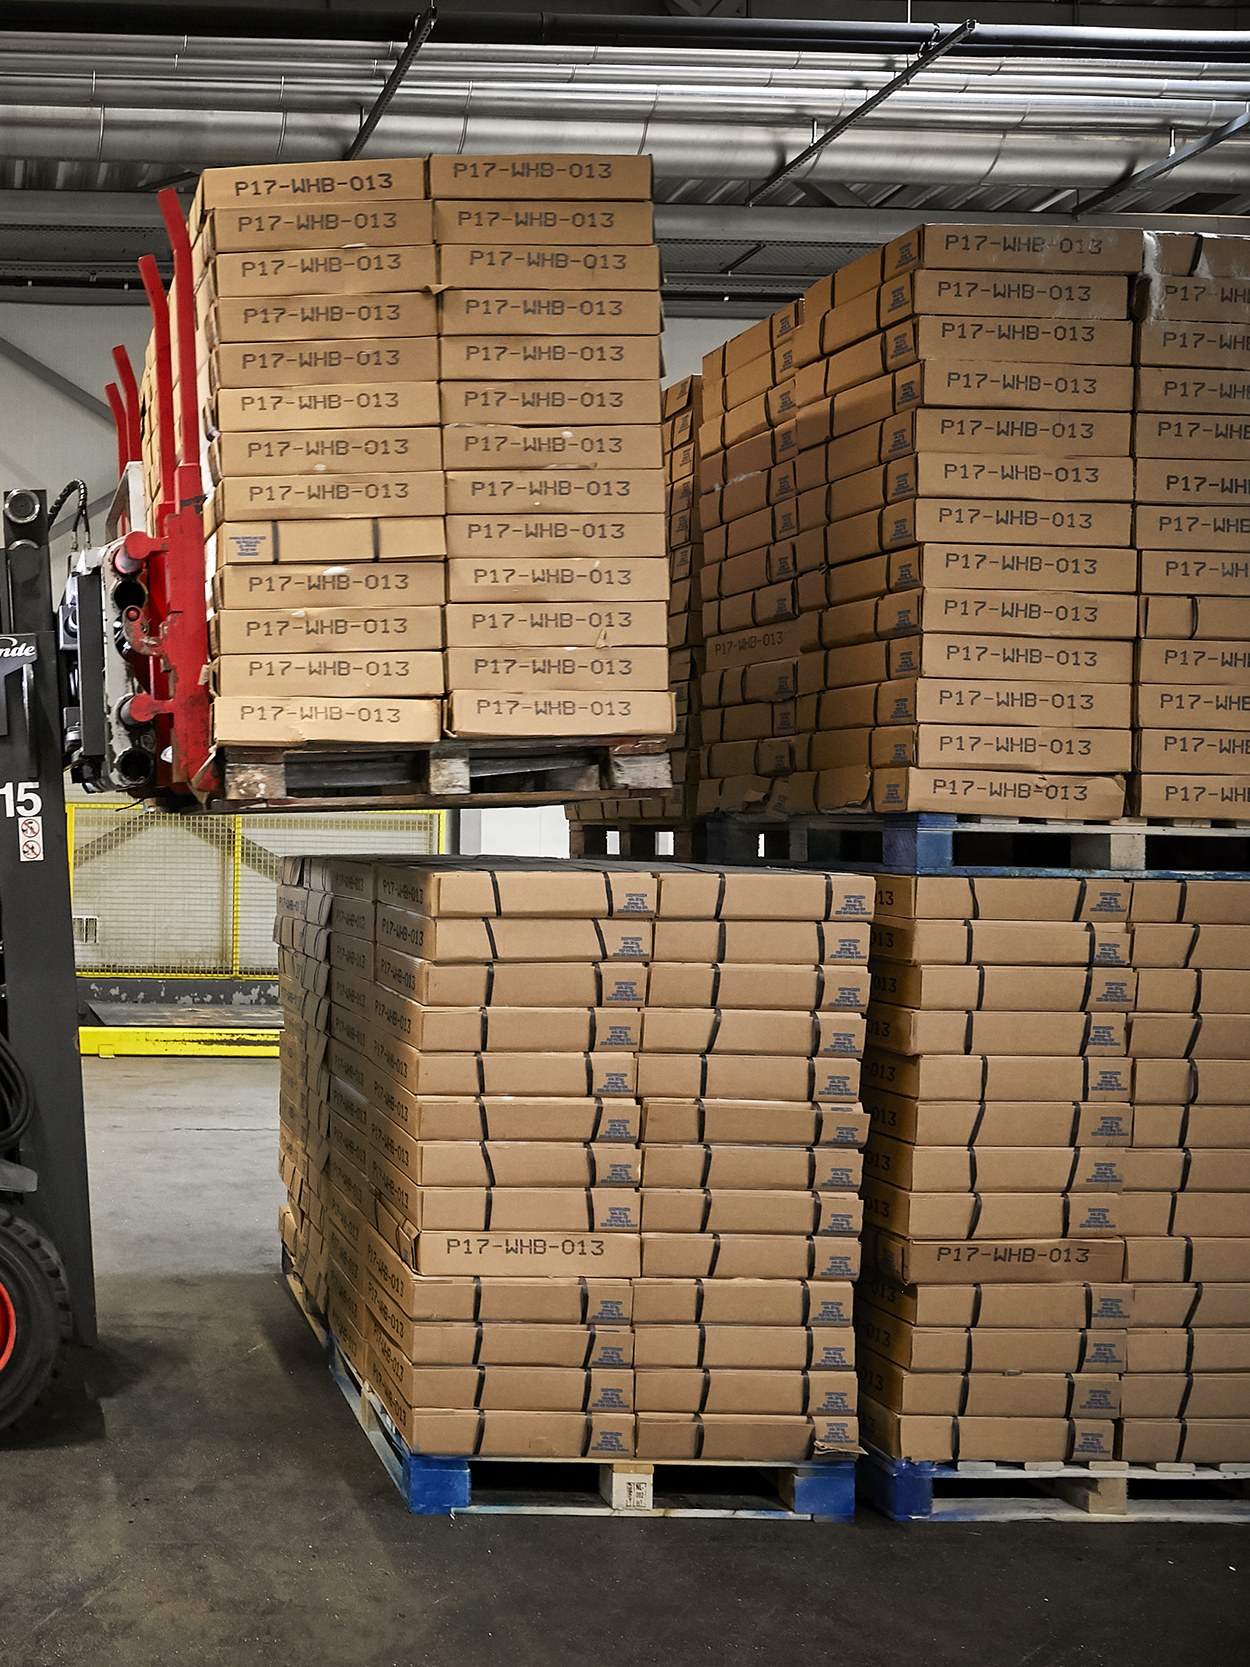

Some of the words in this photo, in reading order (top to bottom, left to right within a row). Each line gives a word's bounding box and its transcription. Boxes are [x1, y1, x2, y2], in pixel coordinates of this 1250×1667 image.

[453, 162, 612, 179] P17-WHB-013
[235, 173, 393, 196] P17-WHB-013
[238, 213, 397, 232] P17-WHB-013
[458, 211, 614, 229] P17-WHB-013
[945, 235, 1102, 254] P17-WHB-013
[242, 254, 401, 277] P17-WHB-013
[469, 250, 627, 271] P17-WHB-013
[938, 281, 1091, 301] P17-WHB-013
[243, 305, 400, 324] P17-WHB-013
[465, 299, 623, 317] P17-WHB-013
[941, 323, 1095, 342] P17-WHB-013
[242, 350, 400, 370] P17-WHB-013
[466, 345, 624, 363] P17-WHB-013
[947, 372, 1097, 395] P17-WHB-013
[241, 393, 399, 412] P17-WHB-013
[464, 391, 624, 409] P17-WHB-013
[940, 419, 1094, 439] P17-WHB-013
[248, 439, 409, 458] P17-WHB-013
[464, 436, 623, 454] P17-WHB-013
[944, 464, 1099, 483] P17-WHB-013
[249, 482, 409, 501] P17-WHB-013
[471, 480, 630, 497] P17-WHB-013
[939, 508, 1092, 529] P17-WHB-013
[467, 523, 625, 540] P17-WHB-013
[945, 553, 1098, 575] P17-WHB-013
[249, 574, 409, 593] P17-WHB-013
[474, 569, 631, 586] P17-WHB-013
[472, 612, 632, 629] P17-WHB-013
[944, 600, 1098, 623] P17-WHB-013
[246, 618, 408, 637] P17-WHB-013
[715, 631, 784, 656] P17-WHB-013
[946, 645, 1098, 667] P17-WHB-013
[249, 660, 410, 677] P17-WHB-013
[474, 658, 632, 676] P17-WHB-013
[477, 700, 631, 717] P17-WHB-013
[939, 690, 1094, 710] P17-WHB-013
[240, 706, 401, 724] P17-WHB-013
[939, 736, 1092, 756] P17-WHB-013
[933, 779, 1088, 801] P17-WHB-013
[382, 879, 424, 904] P17-WHB-013
[381, 918, 424, 947] P17-WHB-013
[381, 959, 416, 990] P17-WHB-013
[375, 1000, 412, 1034] P17-WHB-013
[446, 1238, 605, 1256] P17-WHB-013
[937, 1247, 1090, 1263] P17-WHB-013
